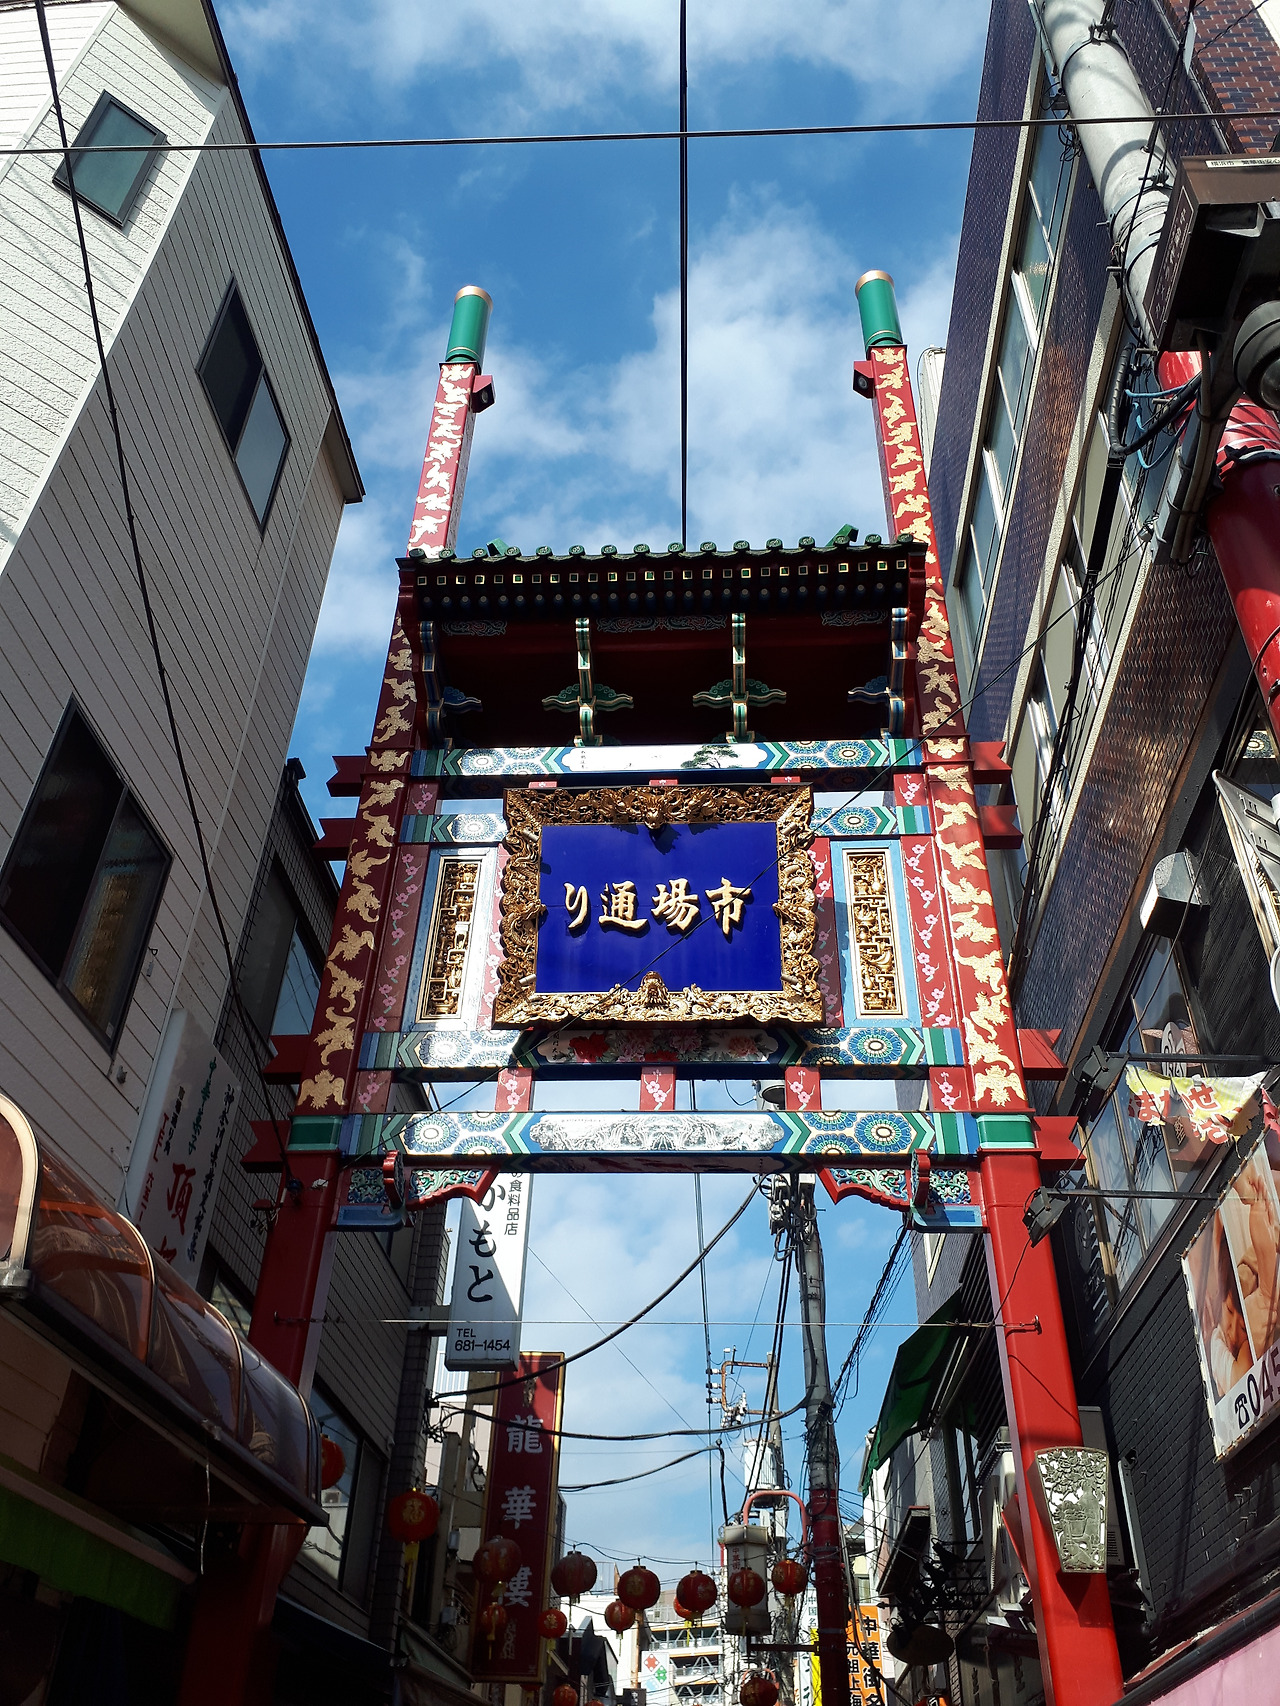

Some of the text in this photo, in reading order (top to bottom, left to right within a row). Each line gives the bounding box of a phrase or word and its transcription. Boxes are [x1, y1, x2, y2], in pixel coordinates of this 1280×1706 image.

[153, 1112, 169, 1163] TEL
[456, 1328, 477, 1338] TEL
[454, 1339, 511, 1351] 681-1454
